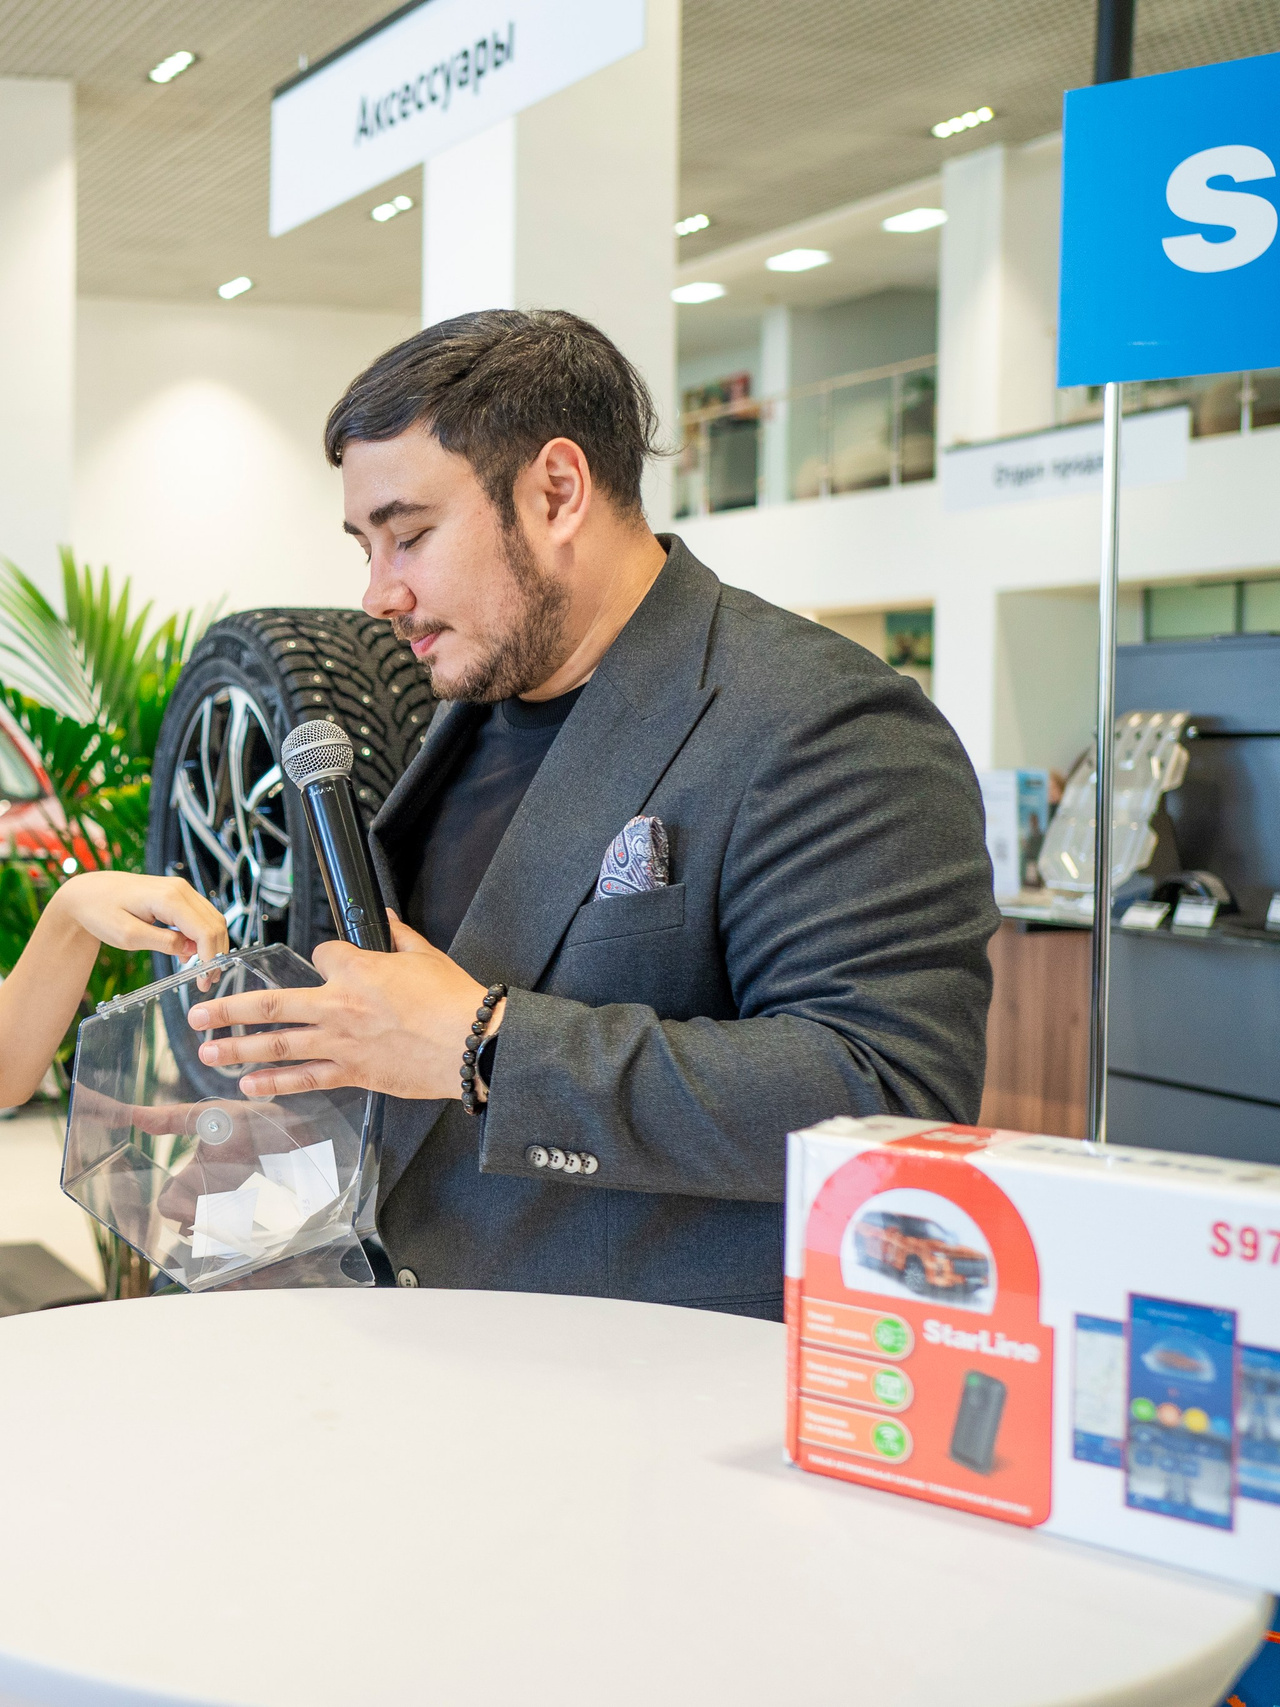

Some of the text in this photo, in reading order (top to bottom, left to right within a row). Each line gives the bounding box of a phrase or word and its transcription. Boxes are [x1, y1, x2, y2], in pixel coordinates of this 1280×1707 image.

[354, 19, 515, 147] Аксессуары
[1162, 145, 1278, 273] S
[922, 1318, 1041, 1364] StarLine
